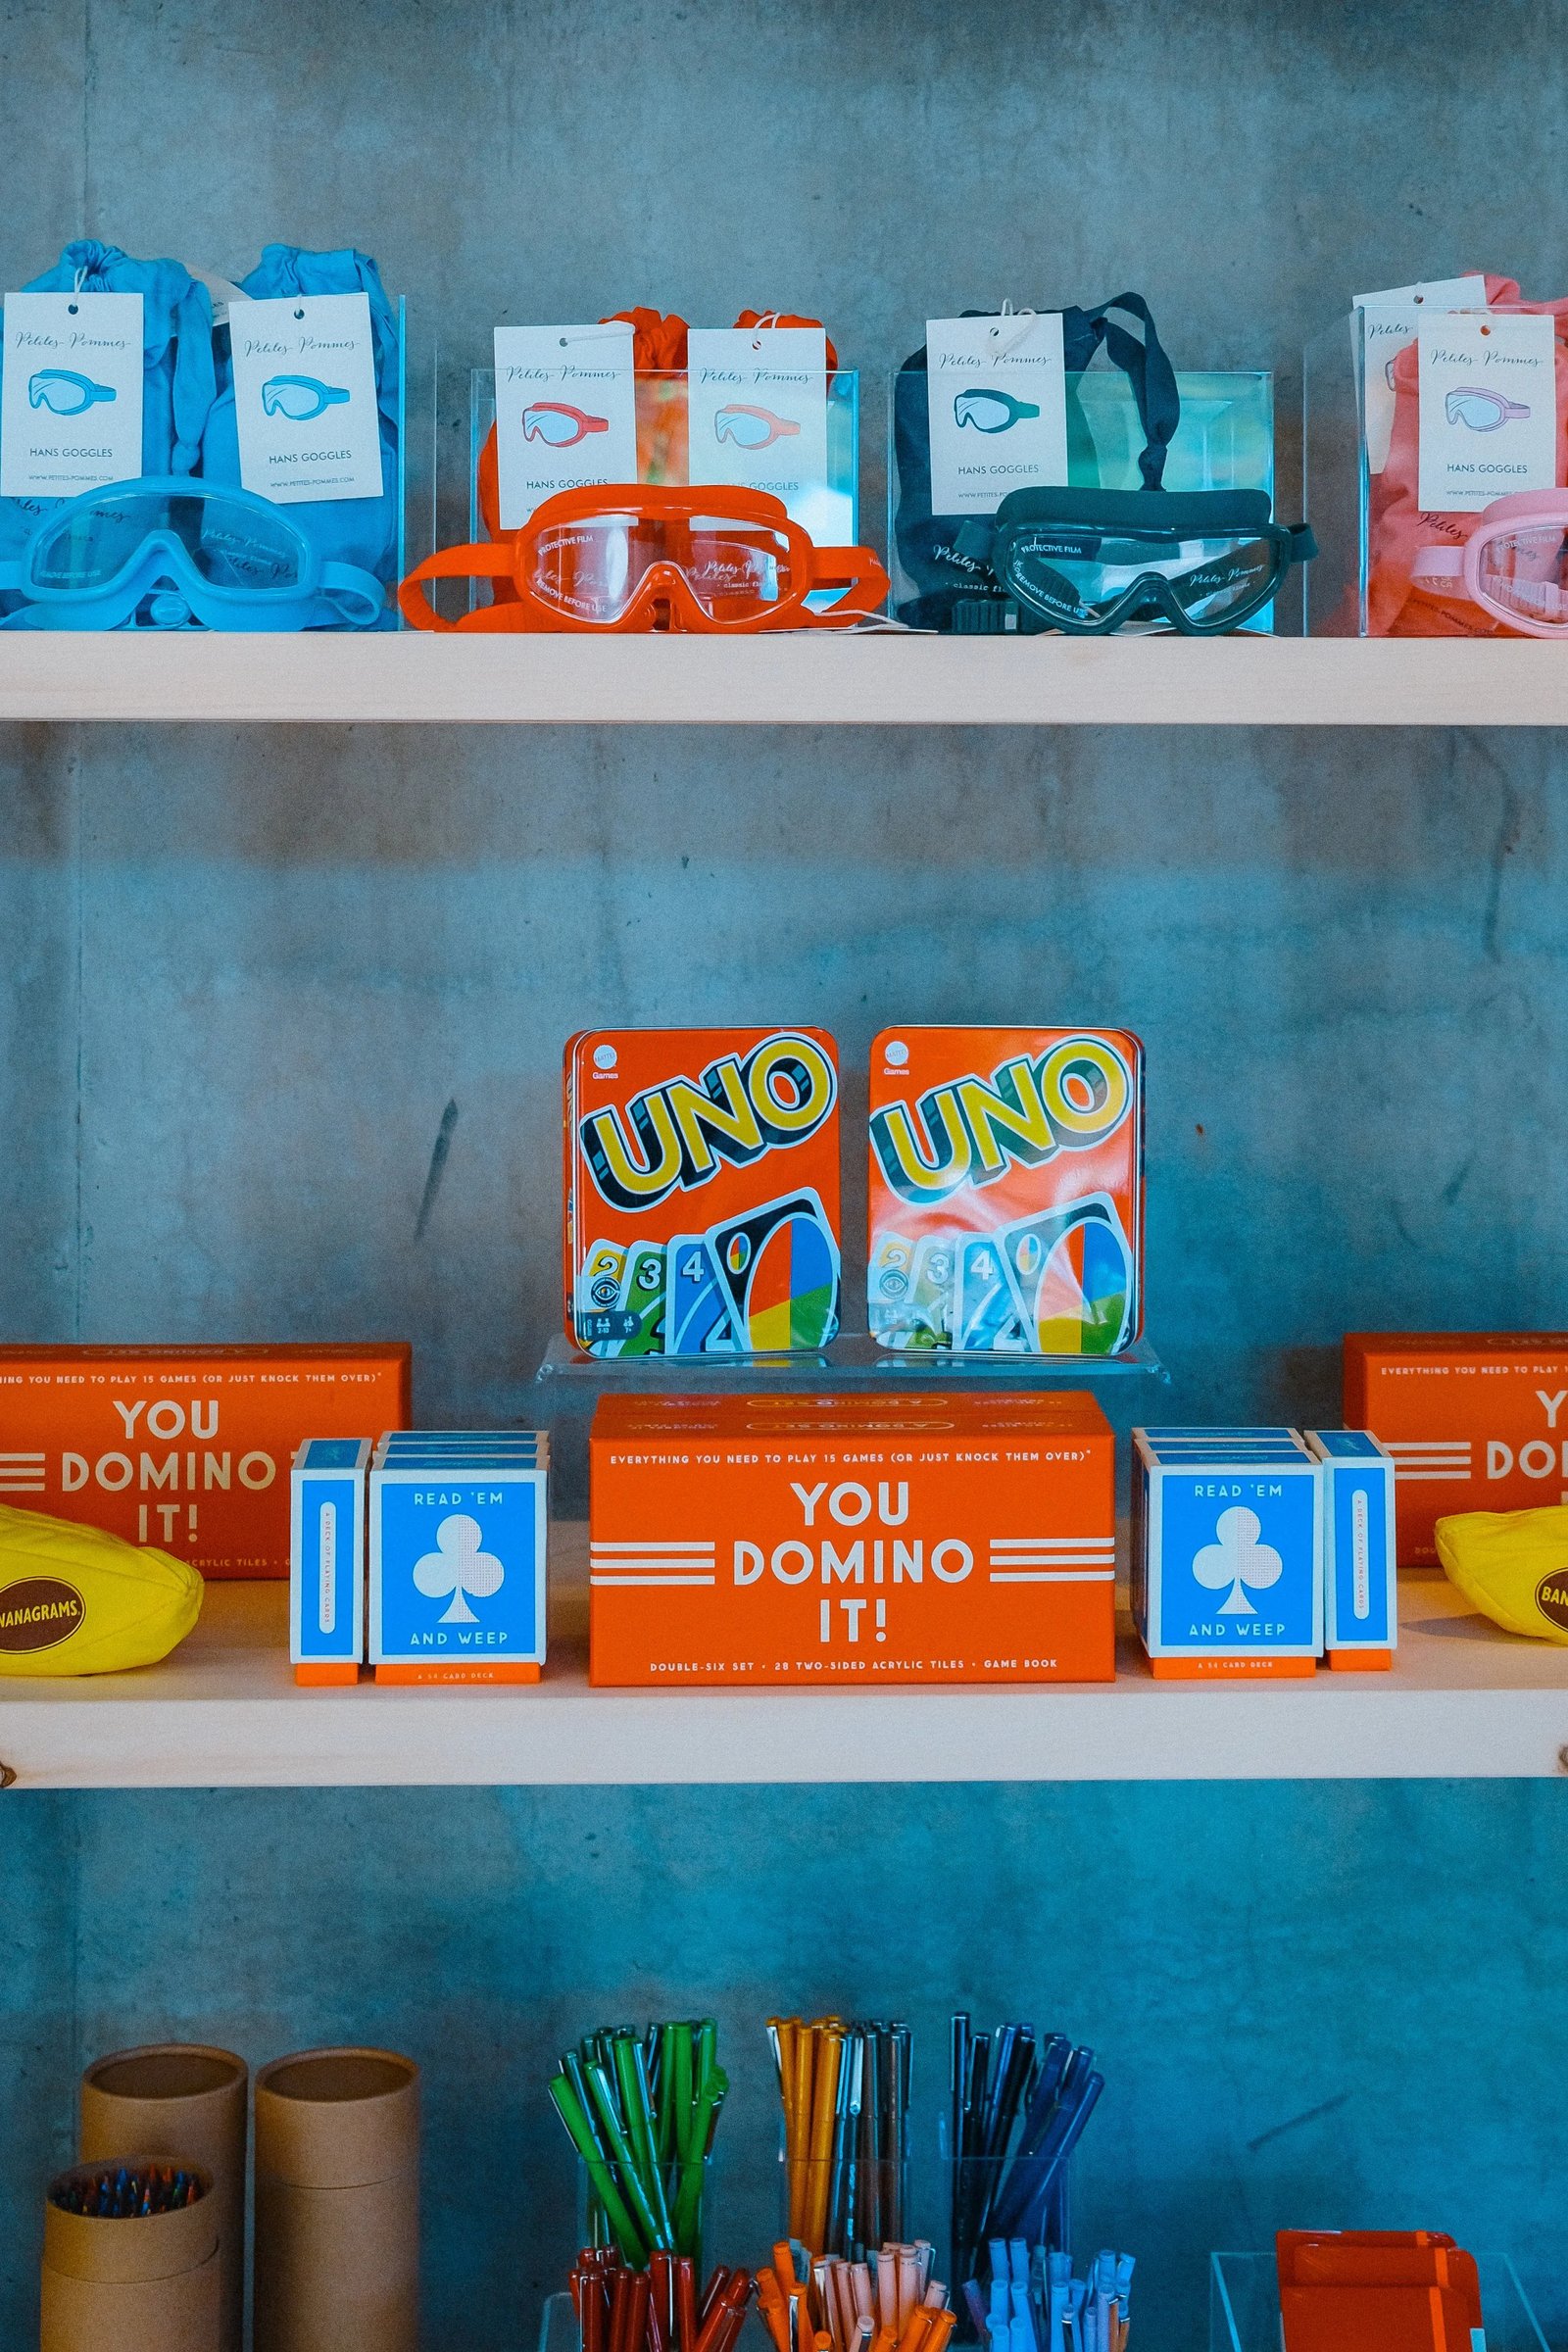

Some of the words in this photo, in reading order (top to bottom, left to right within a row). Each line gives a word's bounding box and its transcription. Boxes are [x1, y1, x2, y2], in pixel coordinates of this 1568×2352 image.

[69, 331, 131, 351] Pommes
[298, 337, 361, 353] Pommes
[992, 352, 1052, 367] Pommes
[1484, 349, 1543, 367] Pommes
[559, 365, 621, 382] Pommes
[753, 367, 814, 384] Pommes
[29, 448, 59, 457] HANS
[62, 448, 113, 457] GOGGLES
[269, 453, 298, 465] HANS
[302, 449, 352, 463] GOGGLES
[958, 466, 986, 474] HANS
[990, 465, 1039, 474] GOGGLES
[1478, 465, 1528, 474] GOGGLES
[526, 480, 555, 490] HANS
[537, 537, 576, 557] PROTECTIVE
[1021, 545, 1064, 555] PROTECTIVE
[1064, 545, 1082, 554] FILM
[536, 578, 564, 600] REMOVE
[564, 596, 590, 610] BEFORE
[1044, 594, 1072, 612] BEFORE
[586, 1035, 835, 1203] UNO
[874, 1037, 1131, 1200] UNO
[594, 1256, 619, 1278] 2
[682, 1250, 704, 1282] 4
[882, 1249, 907, 1268] 2
[970, 1250, 994, 1280] 4
[638, 1258, 662, 1290] 3
[927, 1253, 951, 1284] 3
[160, 1375, 196, 1384] GAMES
[202, 1374, 222, 1384] (OR
[227, 1374, 255, 1383] JUST
[1382, 1366, 1449, 1376] EVERYTHING
[1454, 1366, 1476, 1375] YOU
[112, 1399, 220, 1439] YOU
[610, 1454, 690, 1464] EVERYTHING
[696, 1454, 721, 1464] YOU
[727, 1454, 759, 1464] NEED
[764, 1454, 782, 1464] TO
[788, 1454, 817, 1464] PLAY
[823, 1453, 837, 1463] 15
[843, 1452, 884, 1462] GAMES
[890, 1452, 913, 1462] (OR
[919, 1452, 949, 1462] JUST
[955, 1452, 1000, 1462] KNOCK
[1005, 1452, 1039, 1462] THEM
[63, 1451, 276, 1492] DOMINO
[414, 1492, 463, 1505] READ
[1195, 1484, 1243, 1497] READ
[790, 1481, 909, 1527] YOU
[138, 1503, 198, 1544] IT!
[186, 1558, 231, 1567] CRYLIC
[733, 1539, 974, 1586] DOMINO
[819, 1598, 887, 1642] IT!
[410, 1631, 449, 1645] AND
[457, 1631, 509, 1645] WEEP
[1189, 1623, 1225, 1637] AND
[1237, 1623, 1286, 1637] WEEP
[649, 1662, 725, 1672] DOUBLE-SIX
[731, 1662, 755, 1671] SET
[774, 1662, 790, 1671] 28
[796, 1661, 866, 1670] TWO-SIDED
[872, 1660, 923, 1670] ACRYLIC
[929, 1660, 964, 1670] TILES
[1024, 1659, 1058, 1668] BOOK
